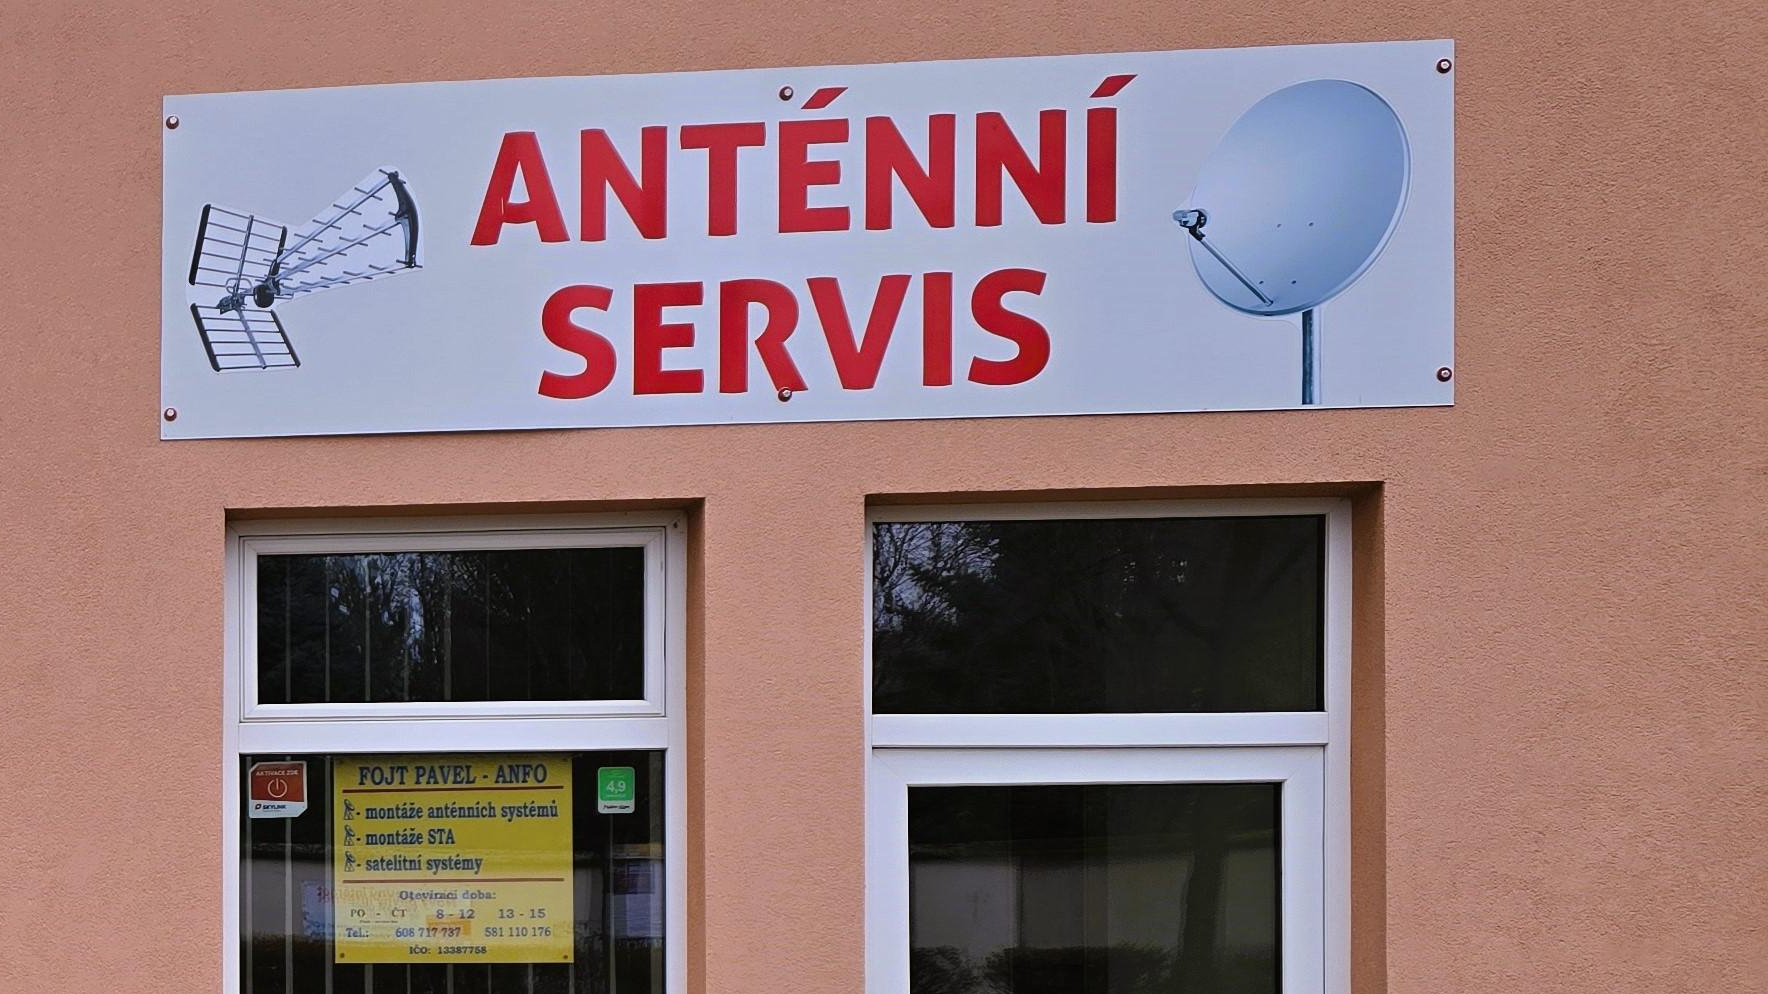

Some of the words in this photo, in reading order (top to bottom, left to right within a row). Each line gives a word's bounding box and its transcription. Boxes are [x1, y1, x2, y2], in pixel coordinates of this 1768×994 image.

[471, 74, 1138, 246] ANTÉNNÍ
[538, 268, 1051, 399] SERVIS
[358, 766, 409, 785] FOJT
[414, 765, 477, 785] PAVEL
[494, 763, 548, 783] ANFO
[365, 802, 424, 820] montáže
[427, 801, 497, 819] anténních
[501, 800, 559, 822] systémů
[365, 827, 424, 846] montáže
[427, 828, 456, 845] STA
[365, 854, 423, 872] satelitní
[426, 853, 483, 875] systémy
[462, 889, 497, 900] doba:
[350, 908, 366, 918] PO
[391, 907, 407, 918] ČT
[435, 909, 445, 919] 8
[459, 908, 476, 919] 12
[498, 908, 515, 919] 13
[529, 908, 546, 919] 15
[346, 927, 369, 938] Tel.:
[395, 927, 415, 937] 608
[418, 927, 438, 937] 717
[441, 926, 461, 937] 737
[484, 926, 504, 937] 581
[508, 926, 528, 937] 110
[531, 926, 552, 937] 176
